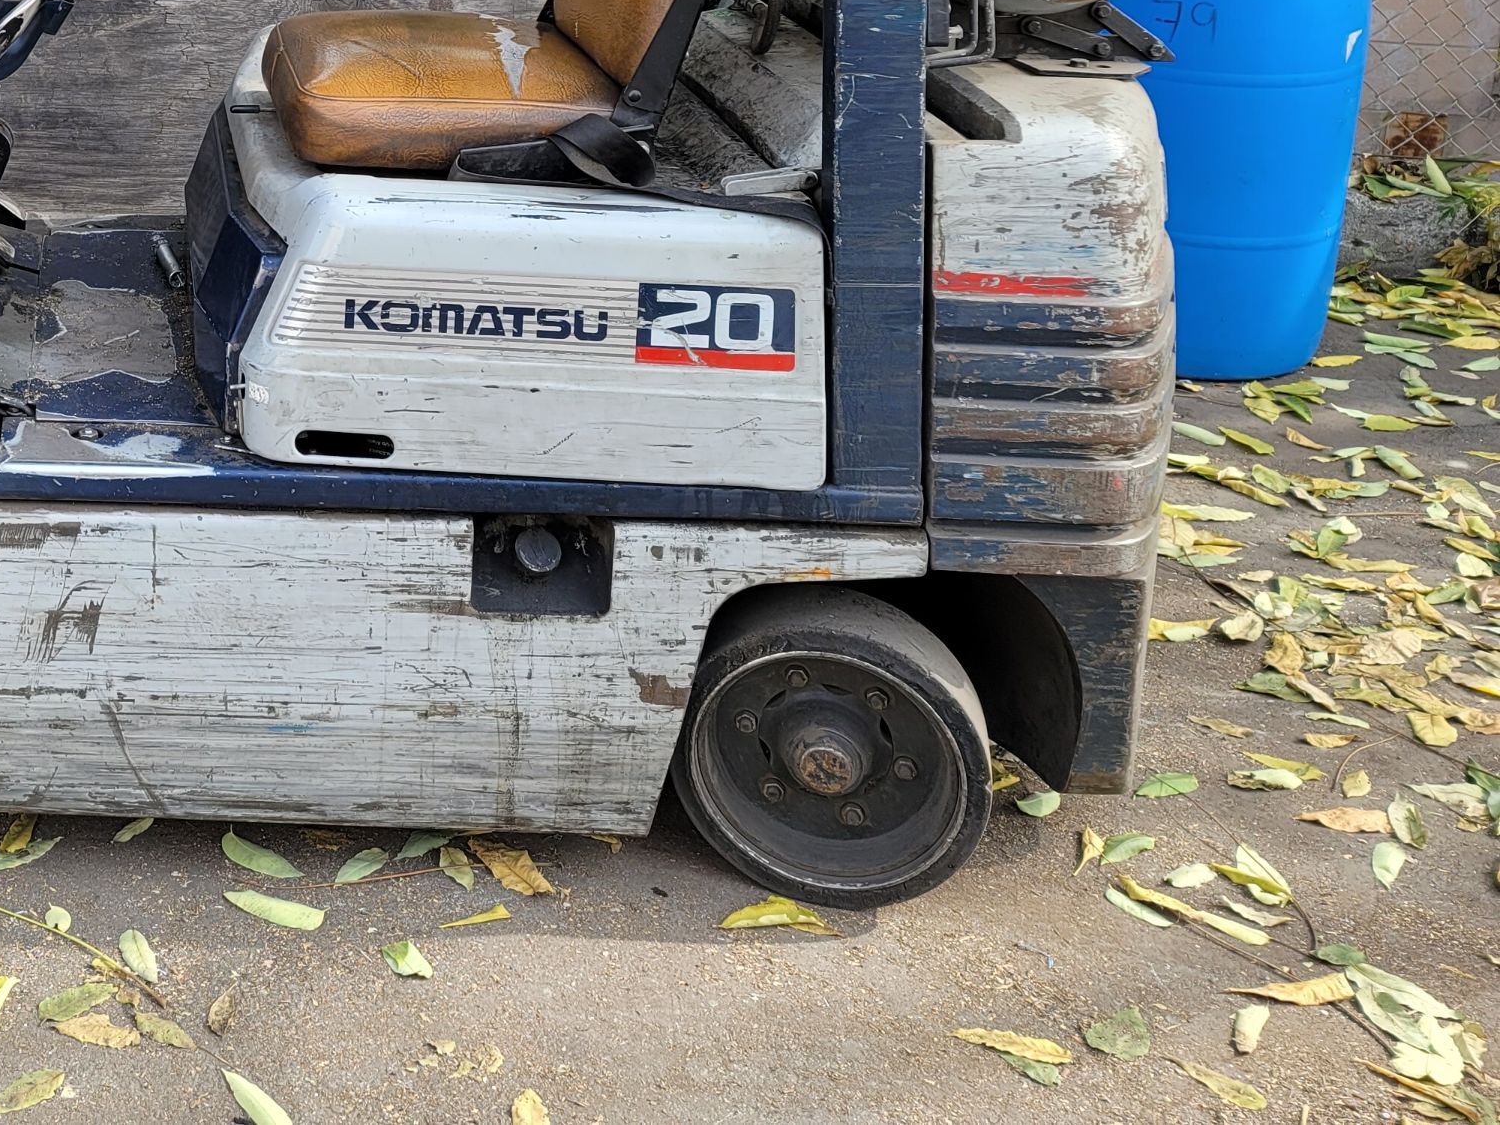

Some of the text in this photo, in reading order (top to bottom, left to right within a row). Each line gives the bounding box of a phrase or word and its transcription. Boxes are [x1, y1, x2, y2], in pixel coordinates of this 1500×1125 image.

[1151, 0, 1218, 43] 79
[343, 288, 774, 351] KOMATSU 20
